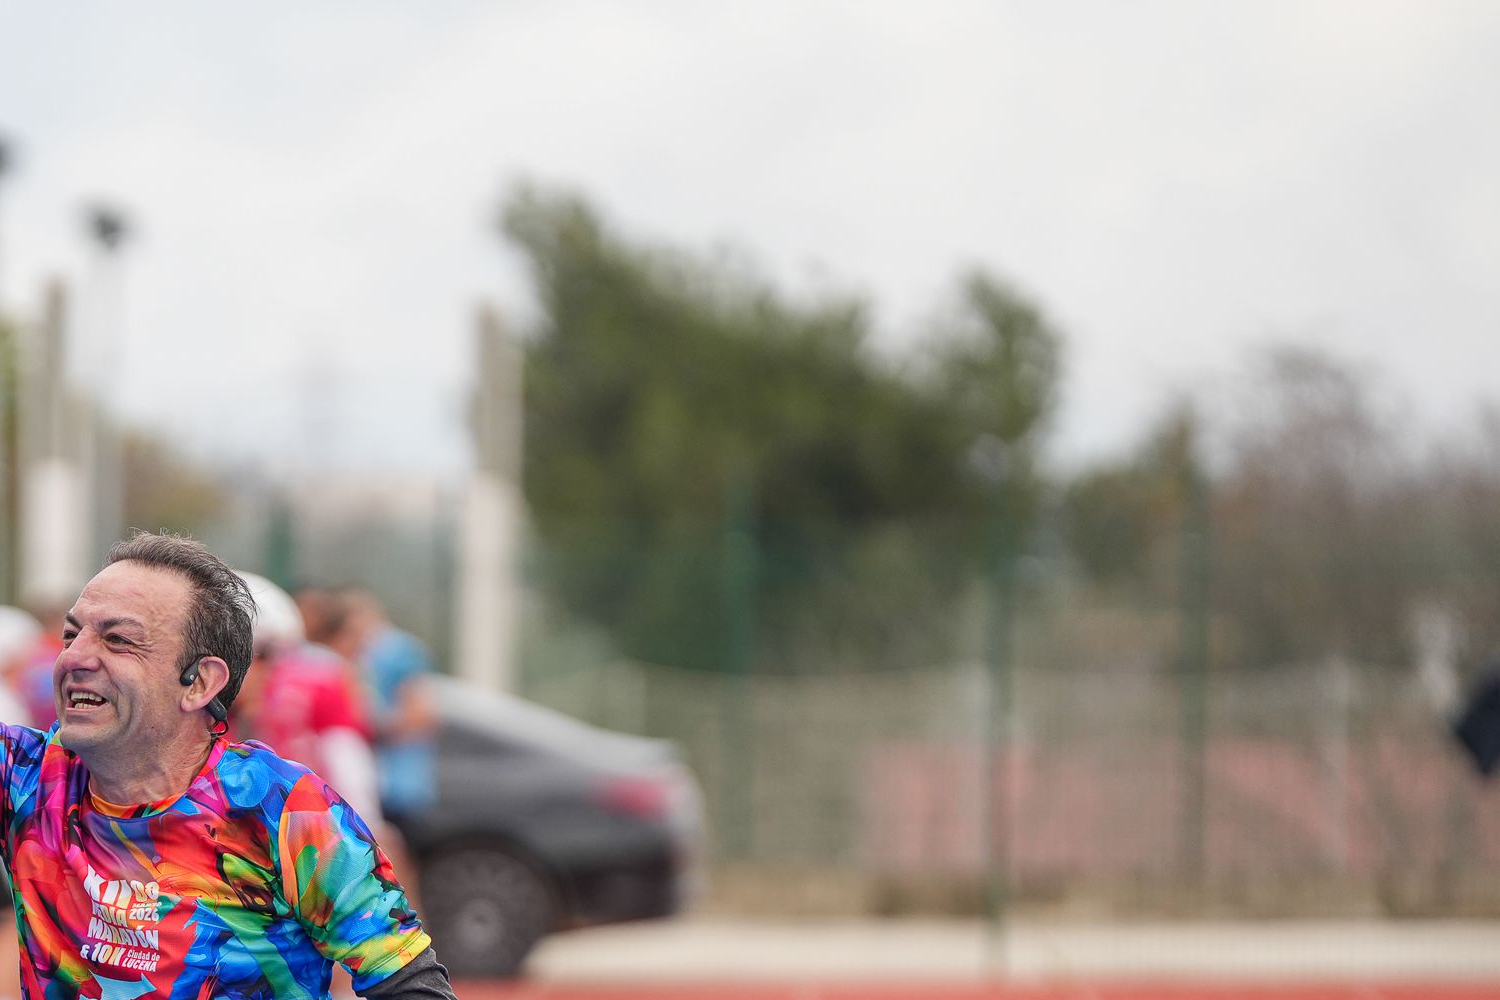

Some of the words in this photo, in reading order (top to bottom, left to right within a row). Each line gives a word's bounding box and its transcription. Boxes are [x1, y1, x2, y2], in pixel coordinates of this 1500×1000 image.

[130, 880, 160, 902] 08
[129, 907, 159, 921] 2026
[87, 916, 159, 951] MARATÓN
[91, 942, 126, 967] 10K
[127, 949, 150, 961] Ciudad
[151, 953, 160, 961] de
[122, 957, 157, 972] LUCENA
